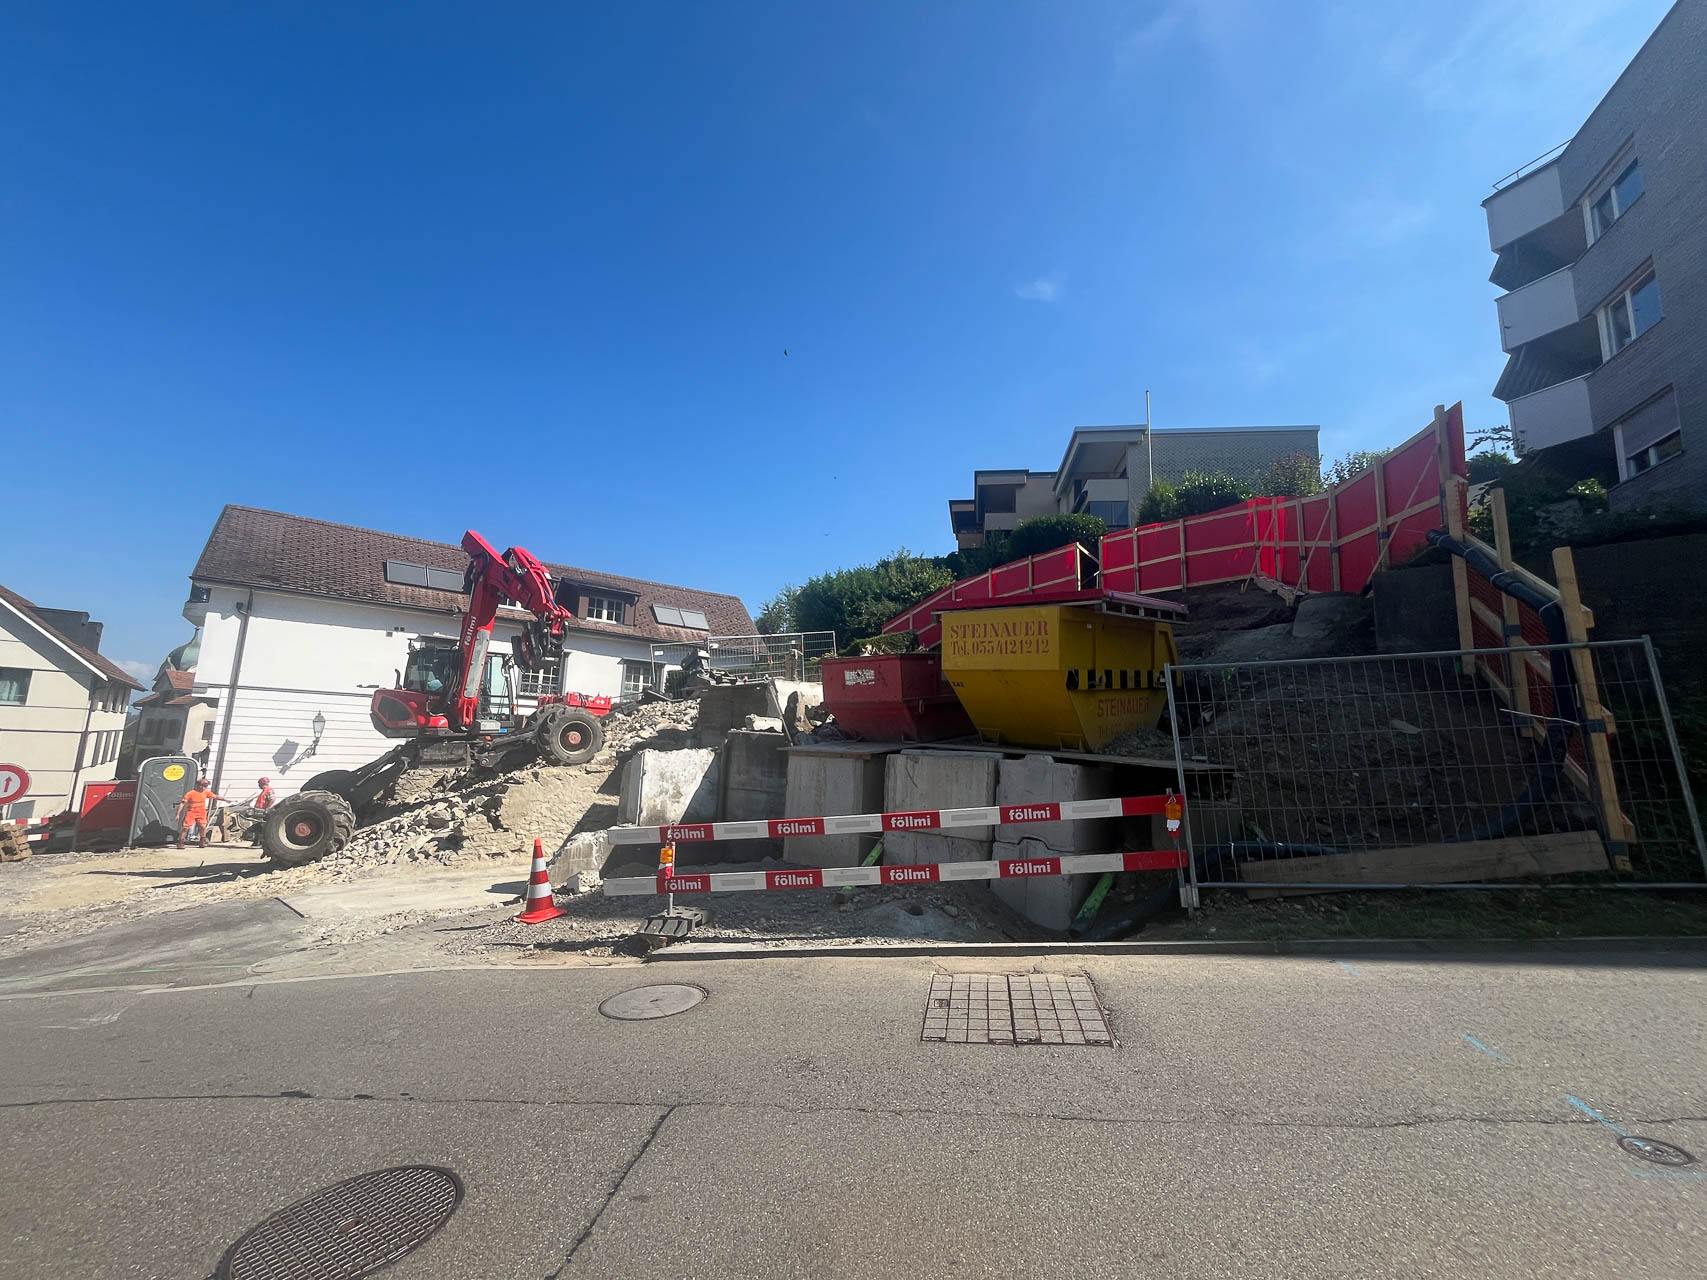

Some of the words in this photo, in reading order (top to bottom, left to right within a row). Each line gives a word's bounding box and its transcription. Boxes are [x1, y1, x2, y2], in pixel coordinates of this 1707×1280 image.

[465, 615, 477, 646] föllmi
[950, 620, 1049, 640] STEINAUER
[776, 821, 816, 834] föllmi
[890, 815, 931, 828] föllmi
[1008, 807, 1051, 821] föllmi
[774, 873, 814, 886] föllmi
[889, 867, 930, 881] föllmi
[1008, 861, 1051, 875] föllmi
